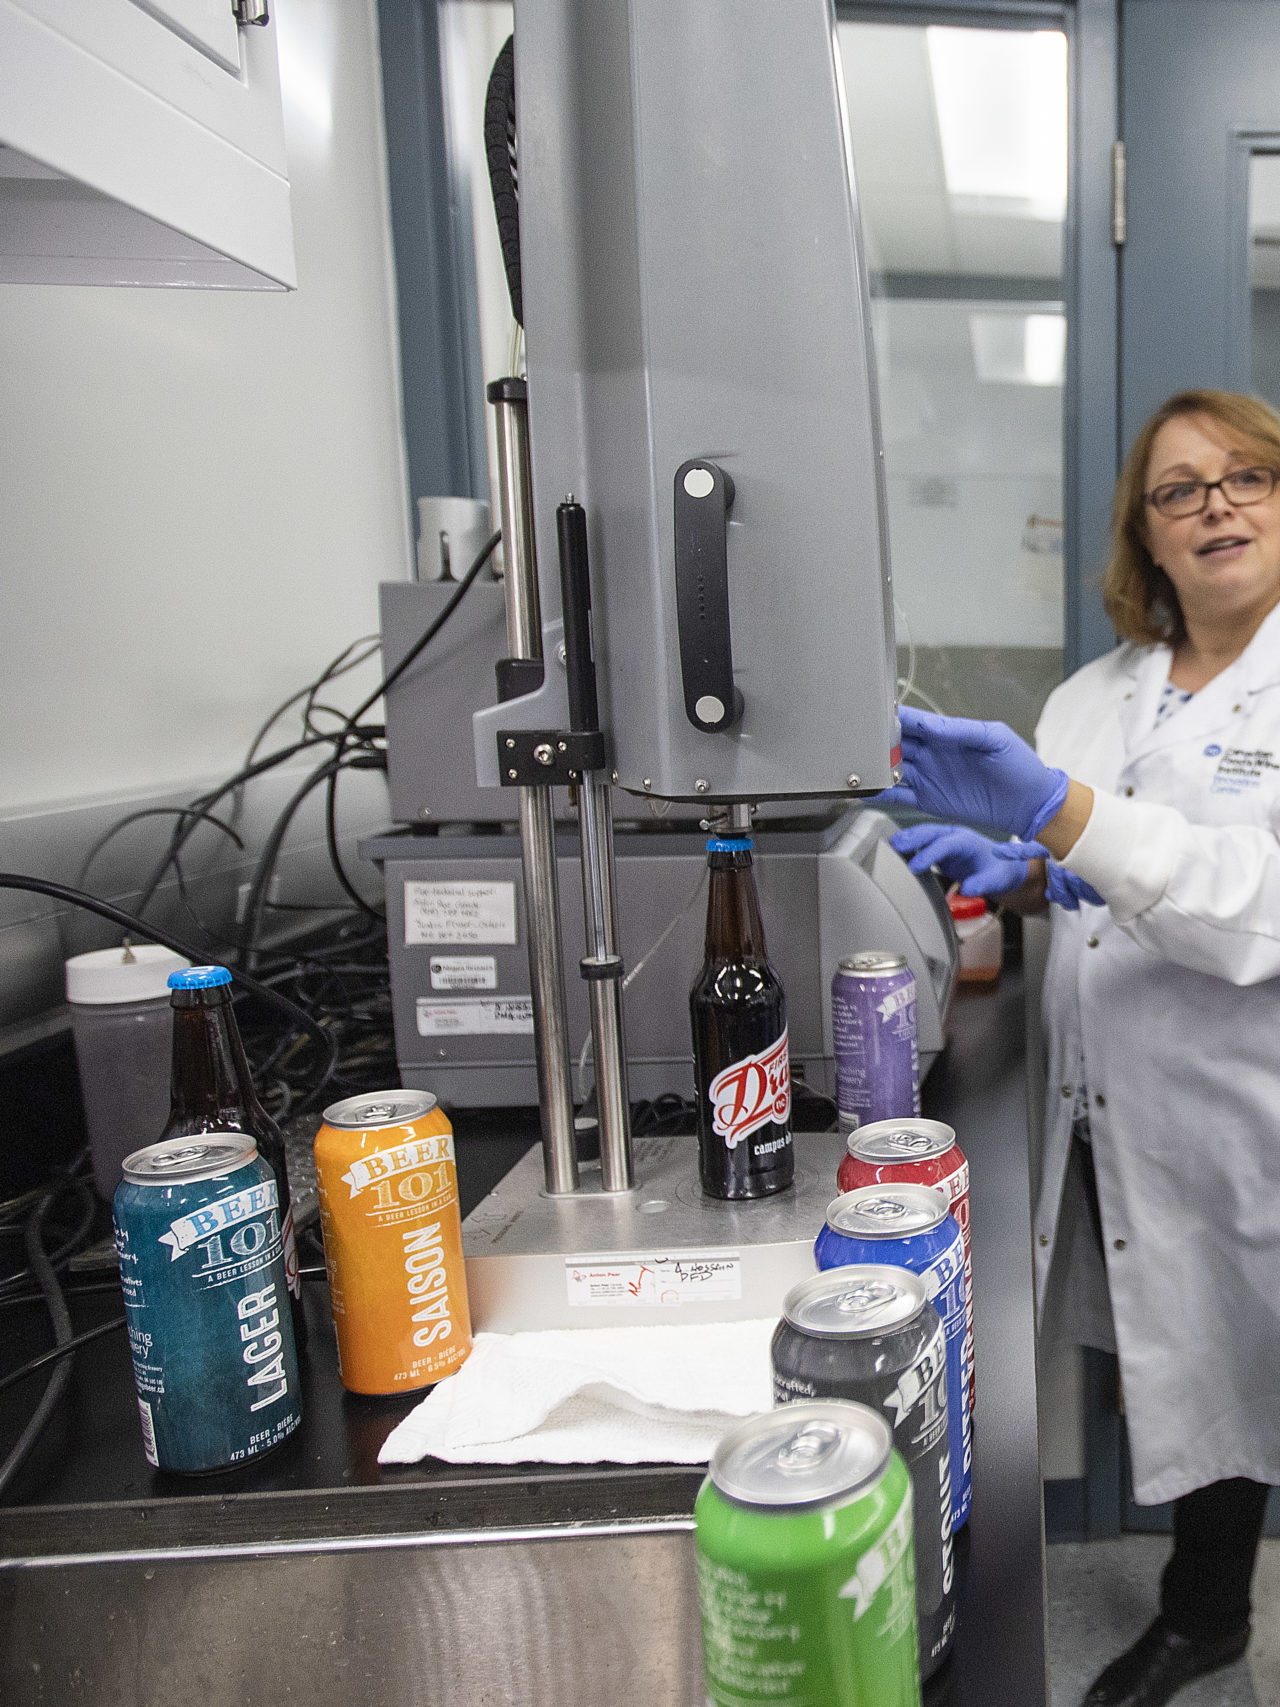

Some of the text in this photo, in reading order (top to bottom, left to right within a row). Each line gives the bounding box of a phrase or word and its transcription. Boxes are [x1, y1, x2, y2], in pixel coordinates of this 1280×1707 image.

[768, 1051, 788, 1074] FIRS
[754, 1137, 785, 1155] campus
[361, 1137, 450, 1180] BEER
[371, 1162, 452, 1209] 101
[186, 1183, 278, 1238] BEER
[386, 1211, 404, 1221] BEER
[406, 1204, 430, 1217] LESSON
[197, 1209, 282, 1269] 101
[208, 1275, 213, 1283] A
[216, 1267, 237, 1281] BEER
[240, 1258, 264, 1273] LESSON
[402, 1222, 452, 1347] SAISON
[237, 1282, 288, 1413] LAGER
[394, 1371, 407, 1381] 473
[410, 1368, 420, 1378] ML
[412, 1356, 432, 1369] BEER
[250, 1429, 271, 1445] BEER
[230, 1450, 245, 1461] 473
[247, 1444, 260, 1456] ML
